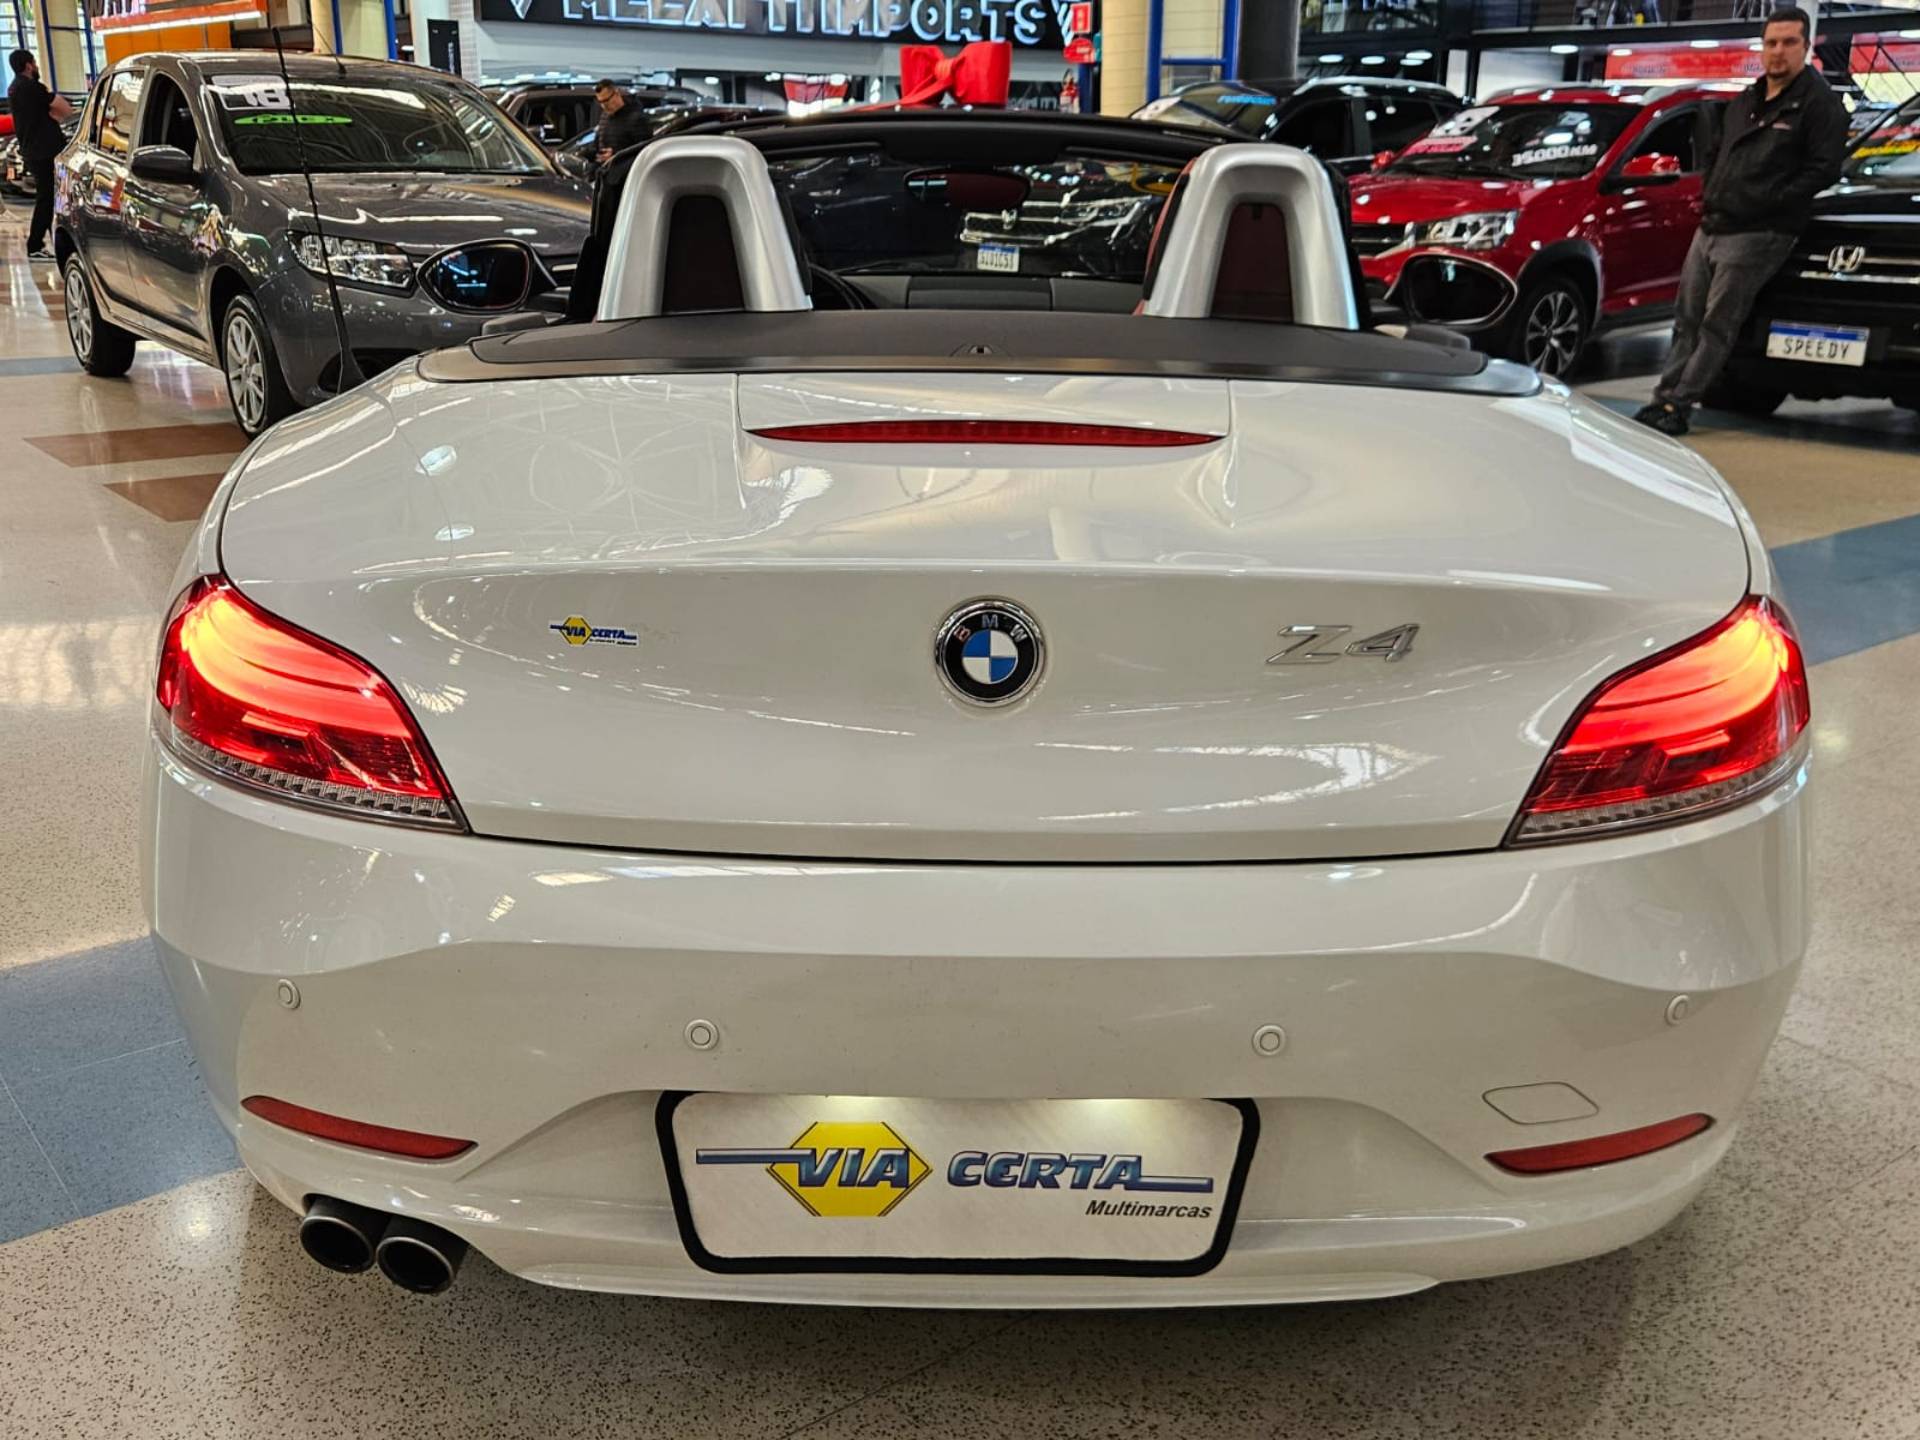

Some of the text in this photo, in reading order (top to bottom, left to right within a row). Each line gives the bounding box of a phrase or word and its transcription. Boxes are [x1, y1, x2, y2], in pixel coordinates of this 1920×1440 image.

[1783, 336, 1850, 359] SPEEDY
[591, 628, 625, 639] CERTA
[953, 613, 1028, 643] BMW
[1265, 623, 1421, 665] Z4
[797, 1147, 1143, 1190] VIA CERTA
[1085, 1199, 1213, 1219] Multimarcas
